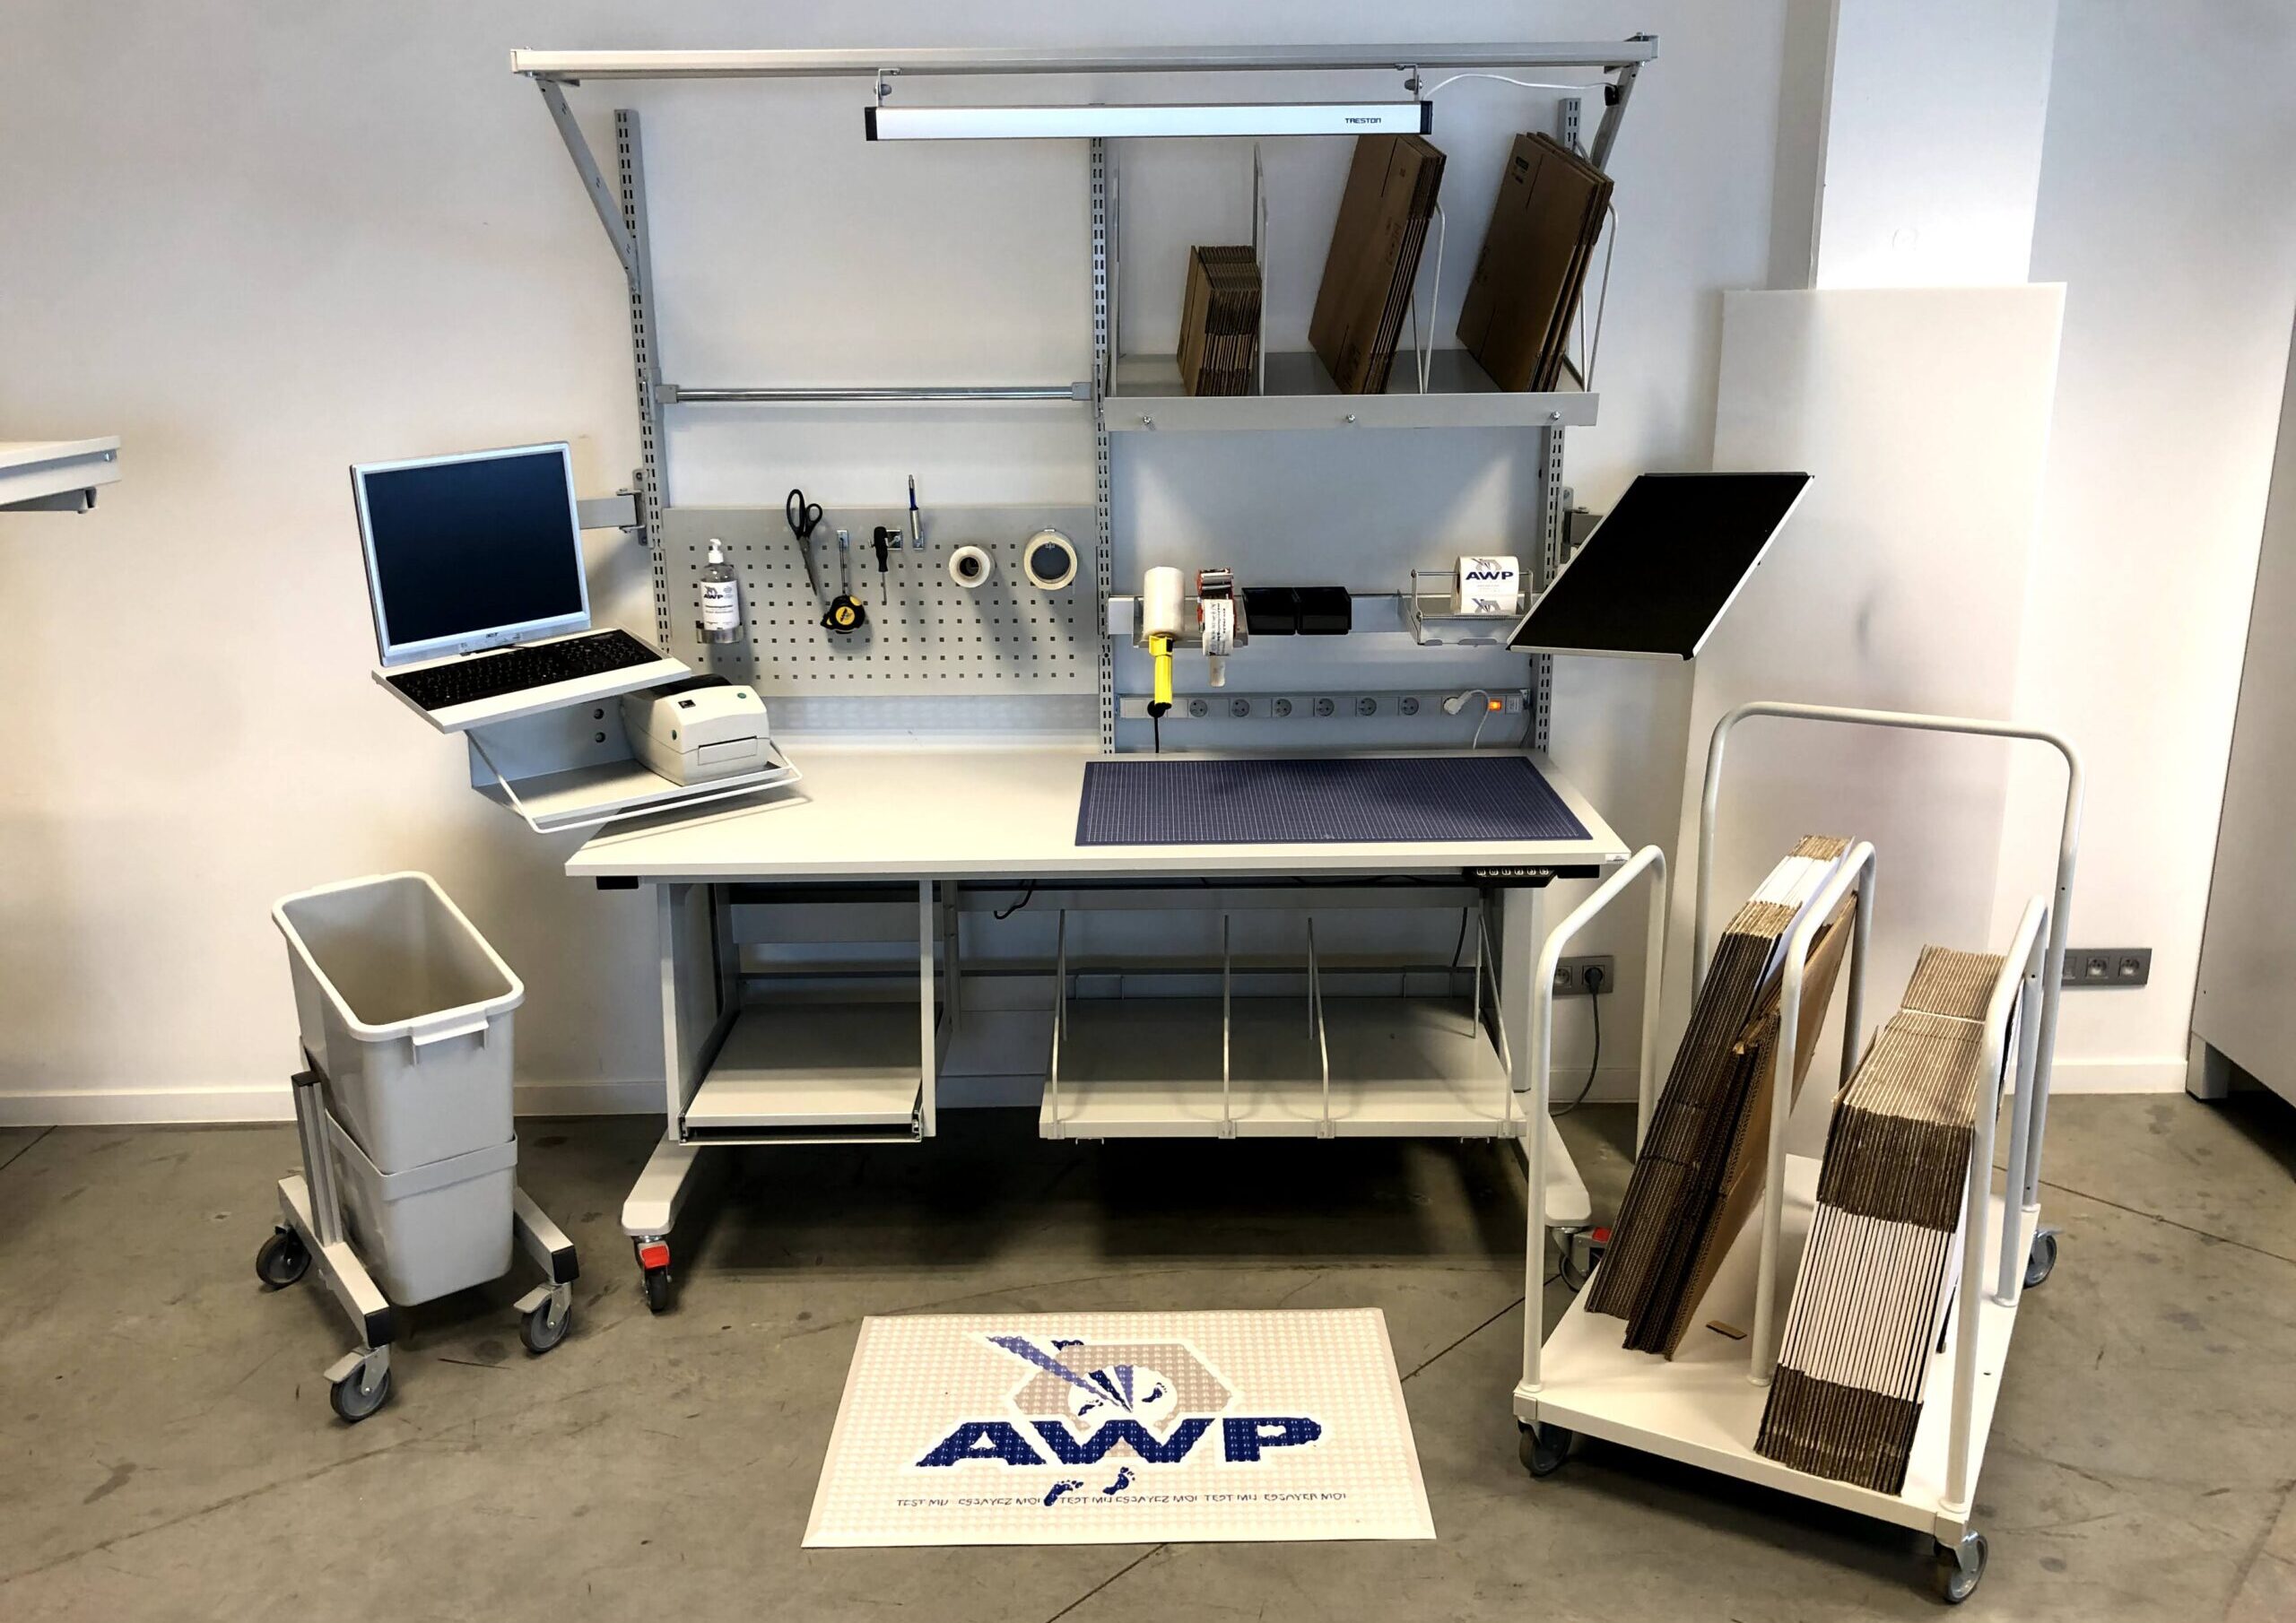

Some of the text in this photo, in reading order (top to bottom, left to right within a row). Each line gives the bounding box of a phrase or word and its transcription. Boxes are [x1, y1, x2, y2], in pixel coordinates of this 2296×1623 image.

[1465, 571, 1513, 580] AWP
[915, 1418, 1322, 1467] AWP
[1173, 1495, 1197, 1503] MOI
